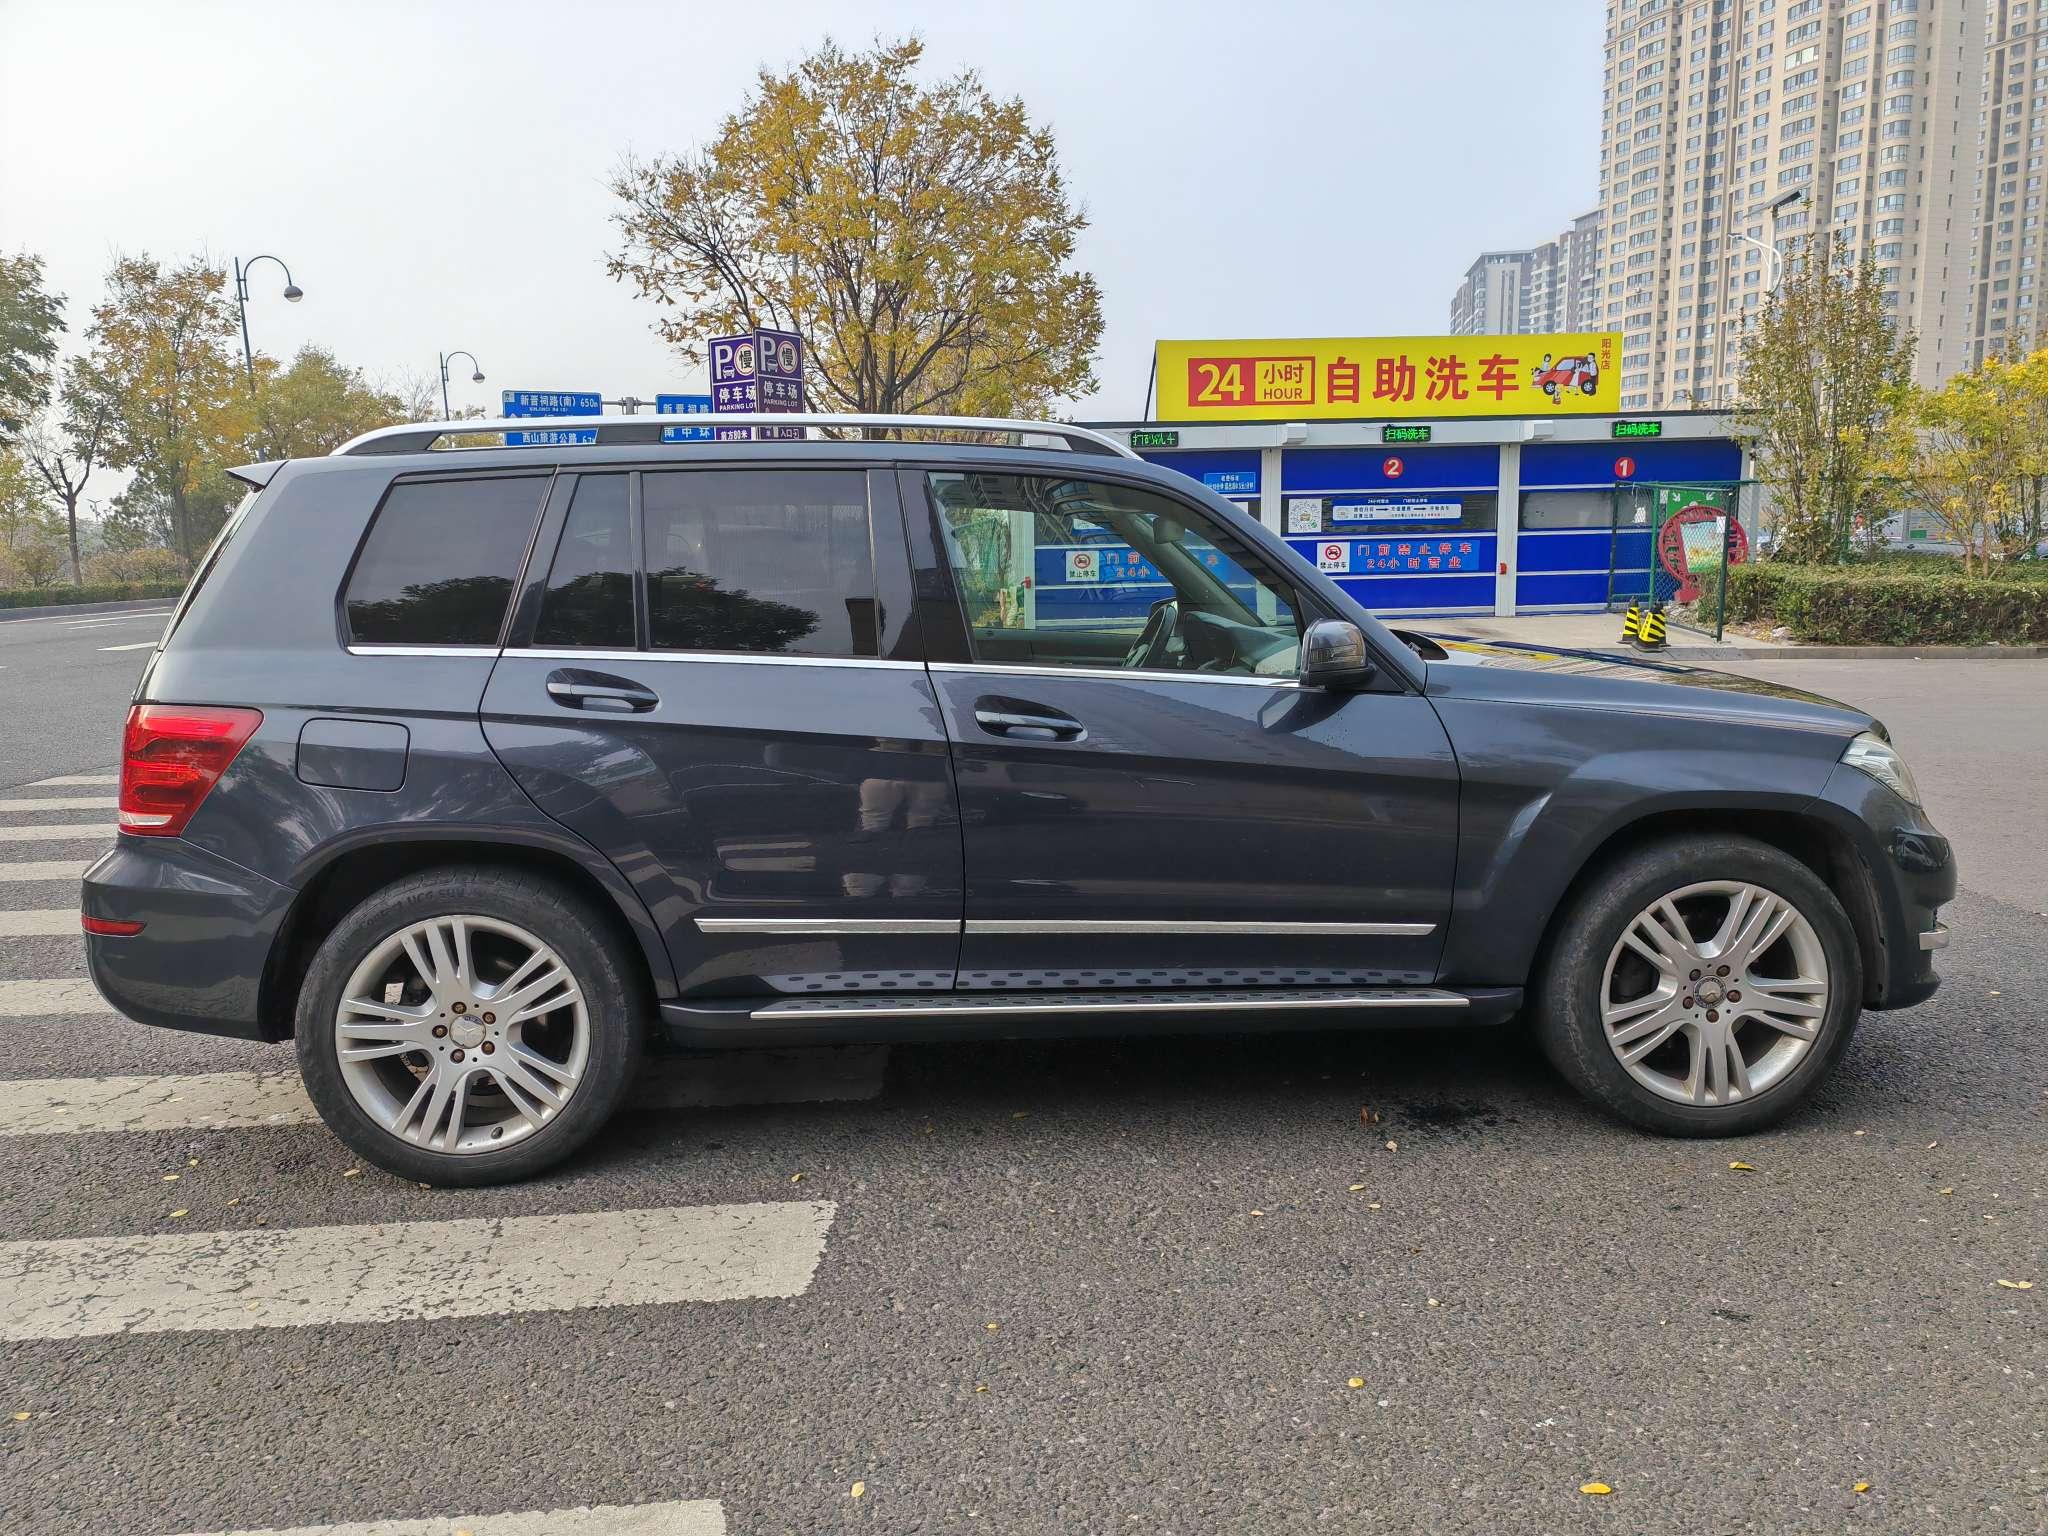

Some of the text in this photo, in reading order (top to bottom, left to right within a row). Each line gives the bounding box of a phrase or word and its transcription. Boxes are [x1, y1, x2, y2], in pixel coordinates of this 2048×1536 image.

[715, 344, 732, 380] P
[739, 349, 753, 369] 慢
[781, 347, 794, 367] 慢
[1263, 363, 1304, 384] 小时
[1327, 354, 1520, 404] 自助洗车
[763, 380, 798, 400] 停车场
[1198, 363, 1245, 402] 24
[718, 385, 756, 404] 停车场
[1263, 387, 1303, 400] HOUR
[719, 403, 745, 412] PARKING
[763, 398, 787, 407] PARKING
[1385, 428, 1429, 441] 扫码洗车
[1616, 423, 1660, 436] 扫码洗车
[522, 432, 577, 444] 西山旅游公路
[1387, 459, 1400, 475] 2
[1619, 459, 1628, 476] 1
[1357, 542, 1472, 557] 门前禁止停车
[1320, 561, 1348, 570] 禁止停车
[1366, 556, 1462, 569] 24小时营业
[1069, 569, 1097, 578] 禁止停车
